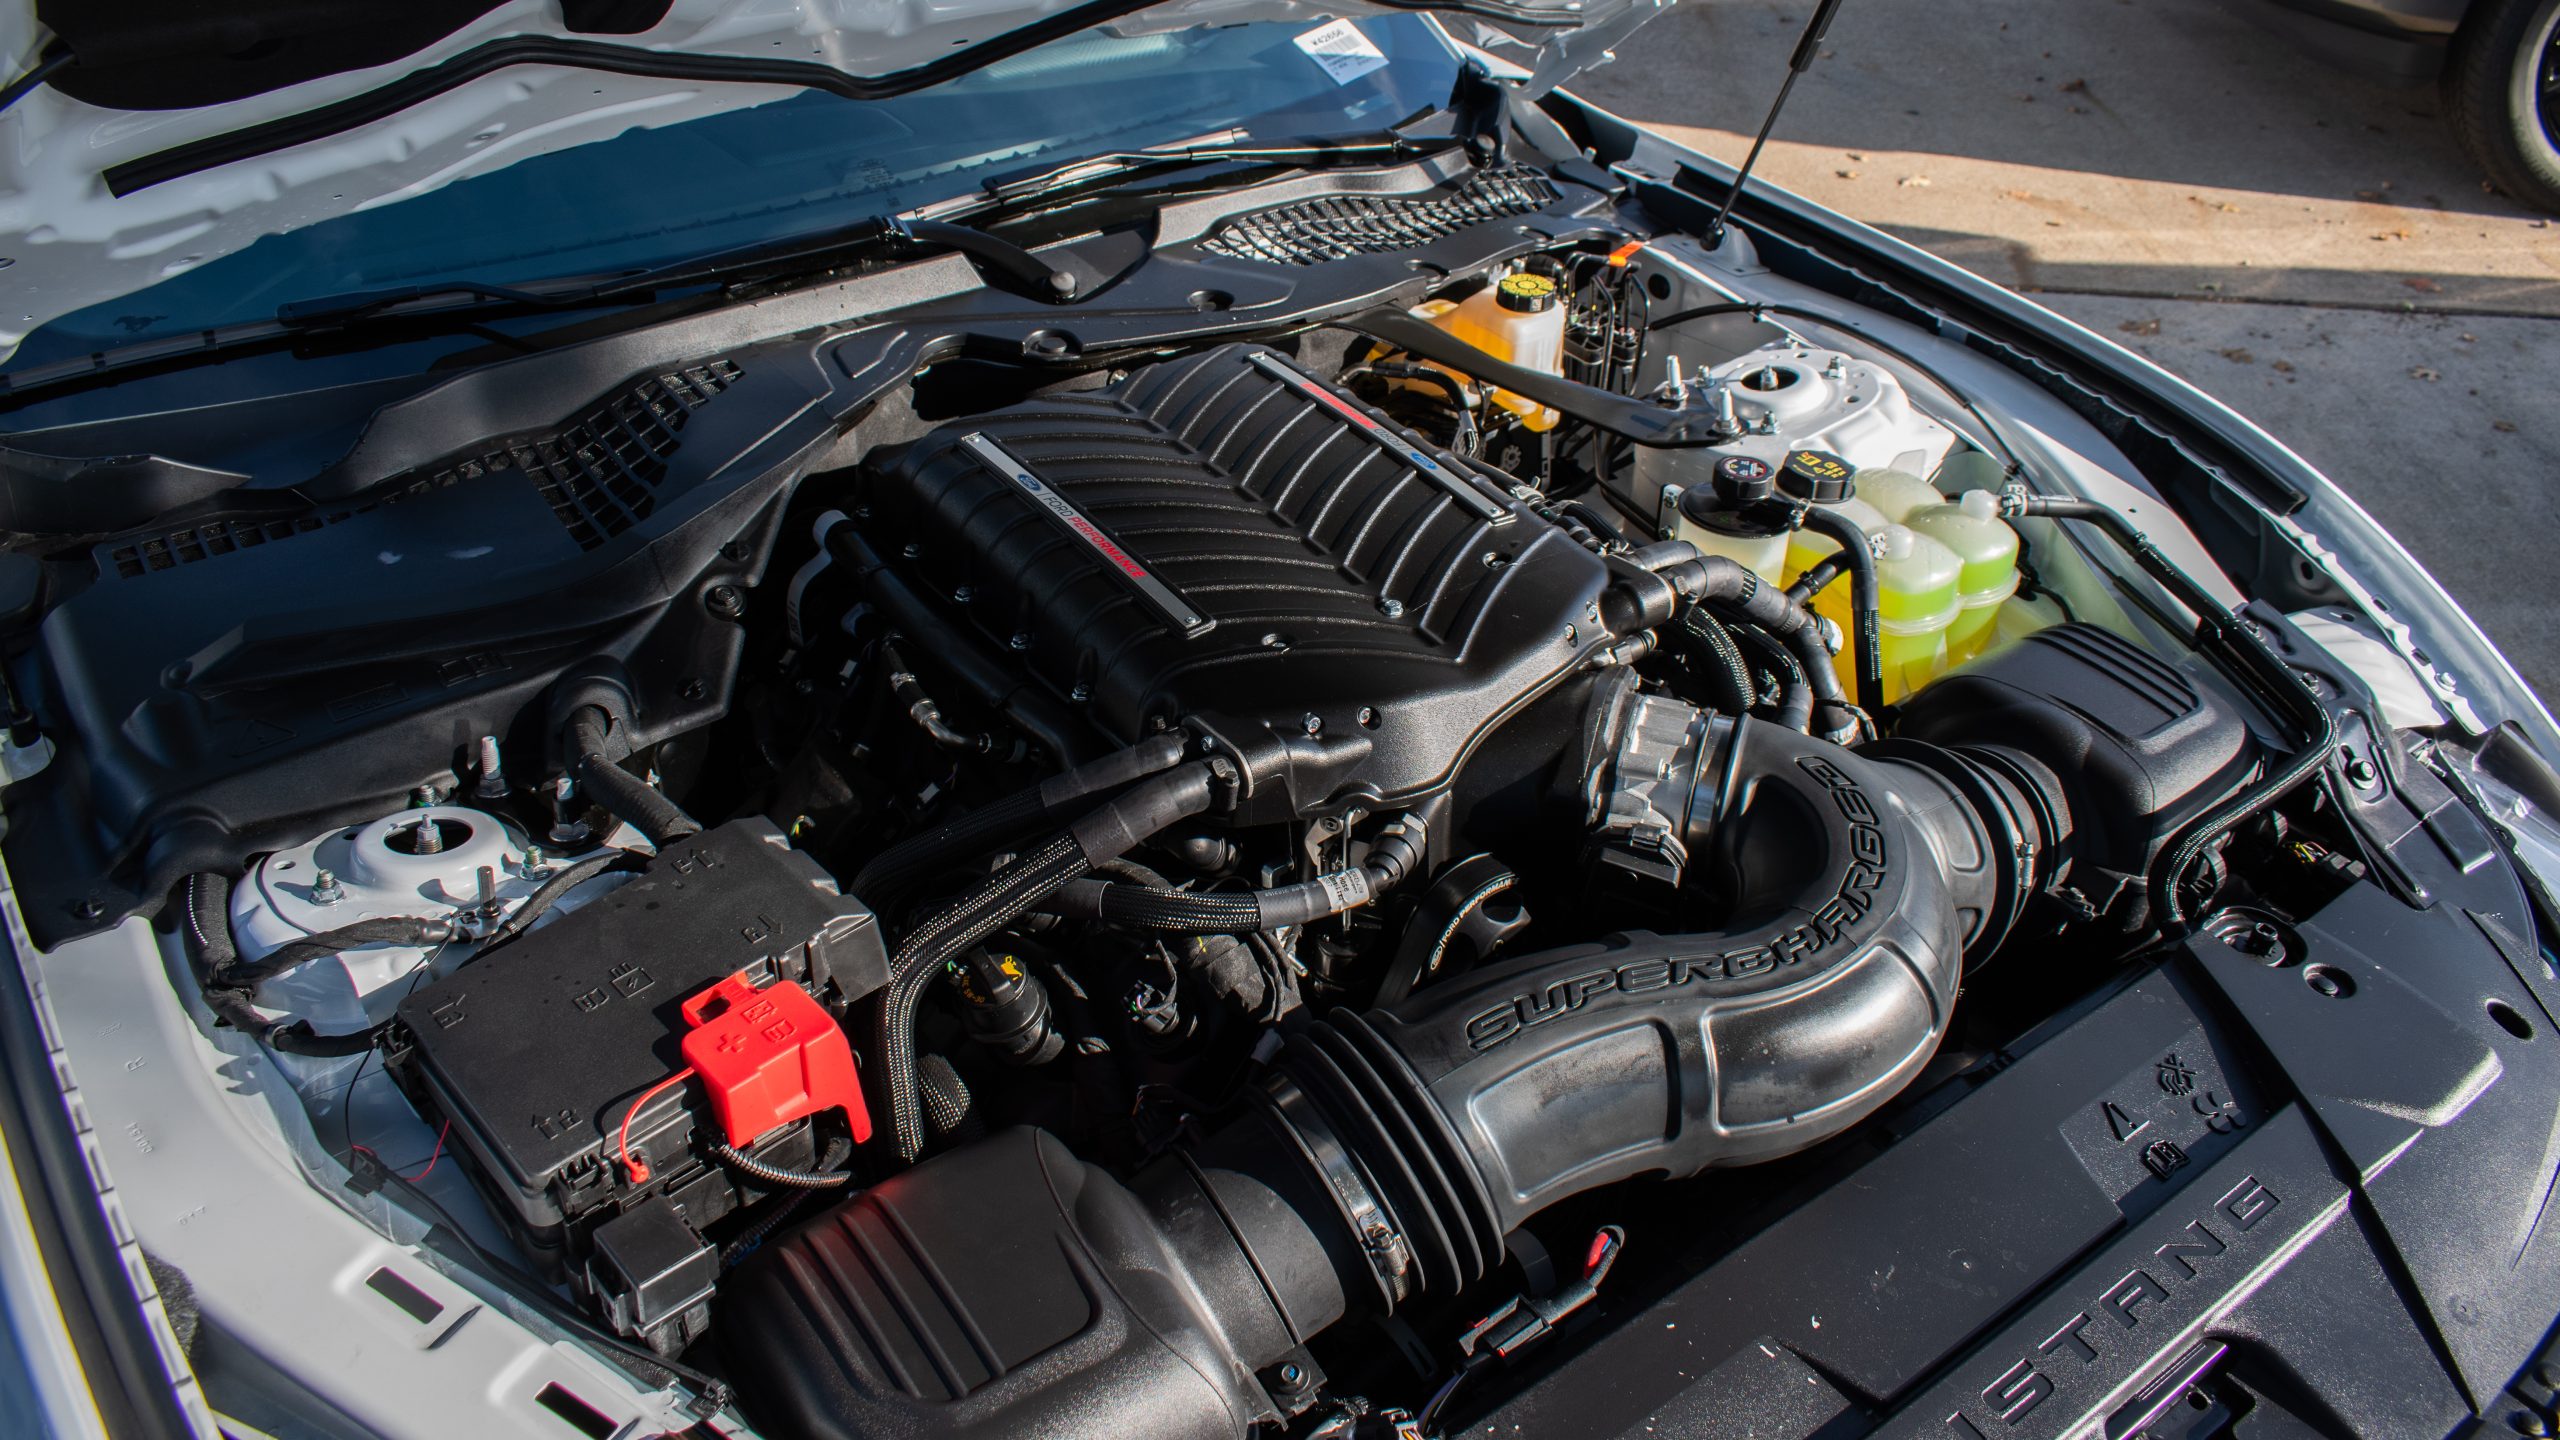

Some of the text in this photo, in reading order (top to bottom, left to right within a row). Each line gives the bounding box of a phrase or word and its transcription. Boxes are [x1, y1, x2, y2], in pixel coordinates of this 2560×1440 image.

[1043, 496, 1073, 517] FORD
[1069, 516, 1148, 578] PERFORMANCE
[1442, 917, 1460, 943] FORD
[1465, 755, 1887, 1050] SUPERCHARGED
